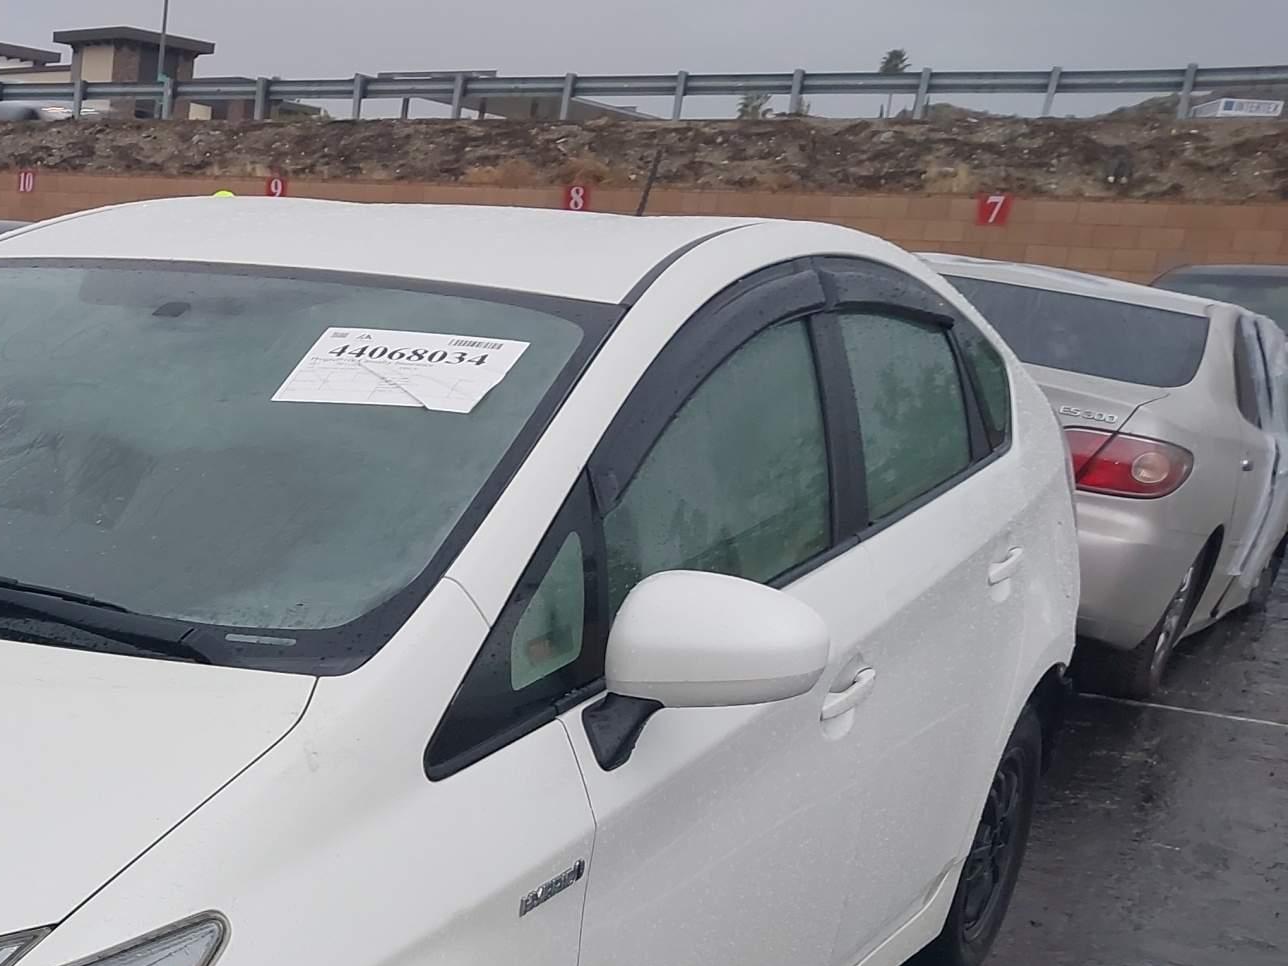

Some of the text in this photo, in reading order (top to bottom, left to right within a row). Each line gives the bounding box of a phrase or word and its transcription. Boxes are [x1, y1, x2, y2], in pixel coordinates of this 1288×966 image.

[19, 172, 33, 192] 10
[270, 178, 282, 197] 9
[569, 186, 584, 210] 8
[986, 195, 1005, 223] 7
[328, 344, 489, 367] 44068034
[1059, 405, 1118, 424] ES 300
